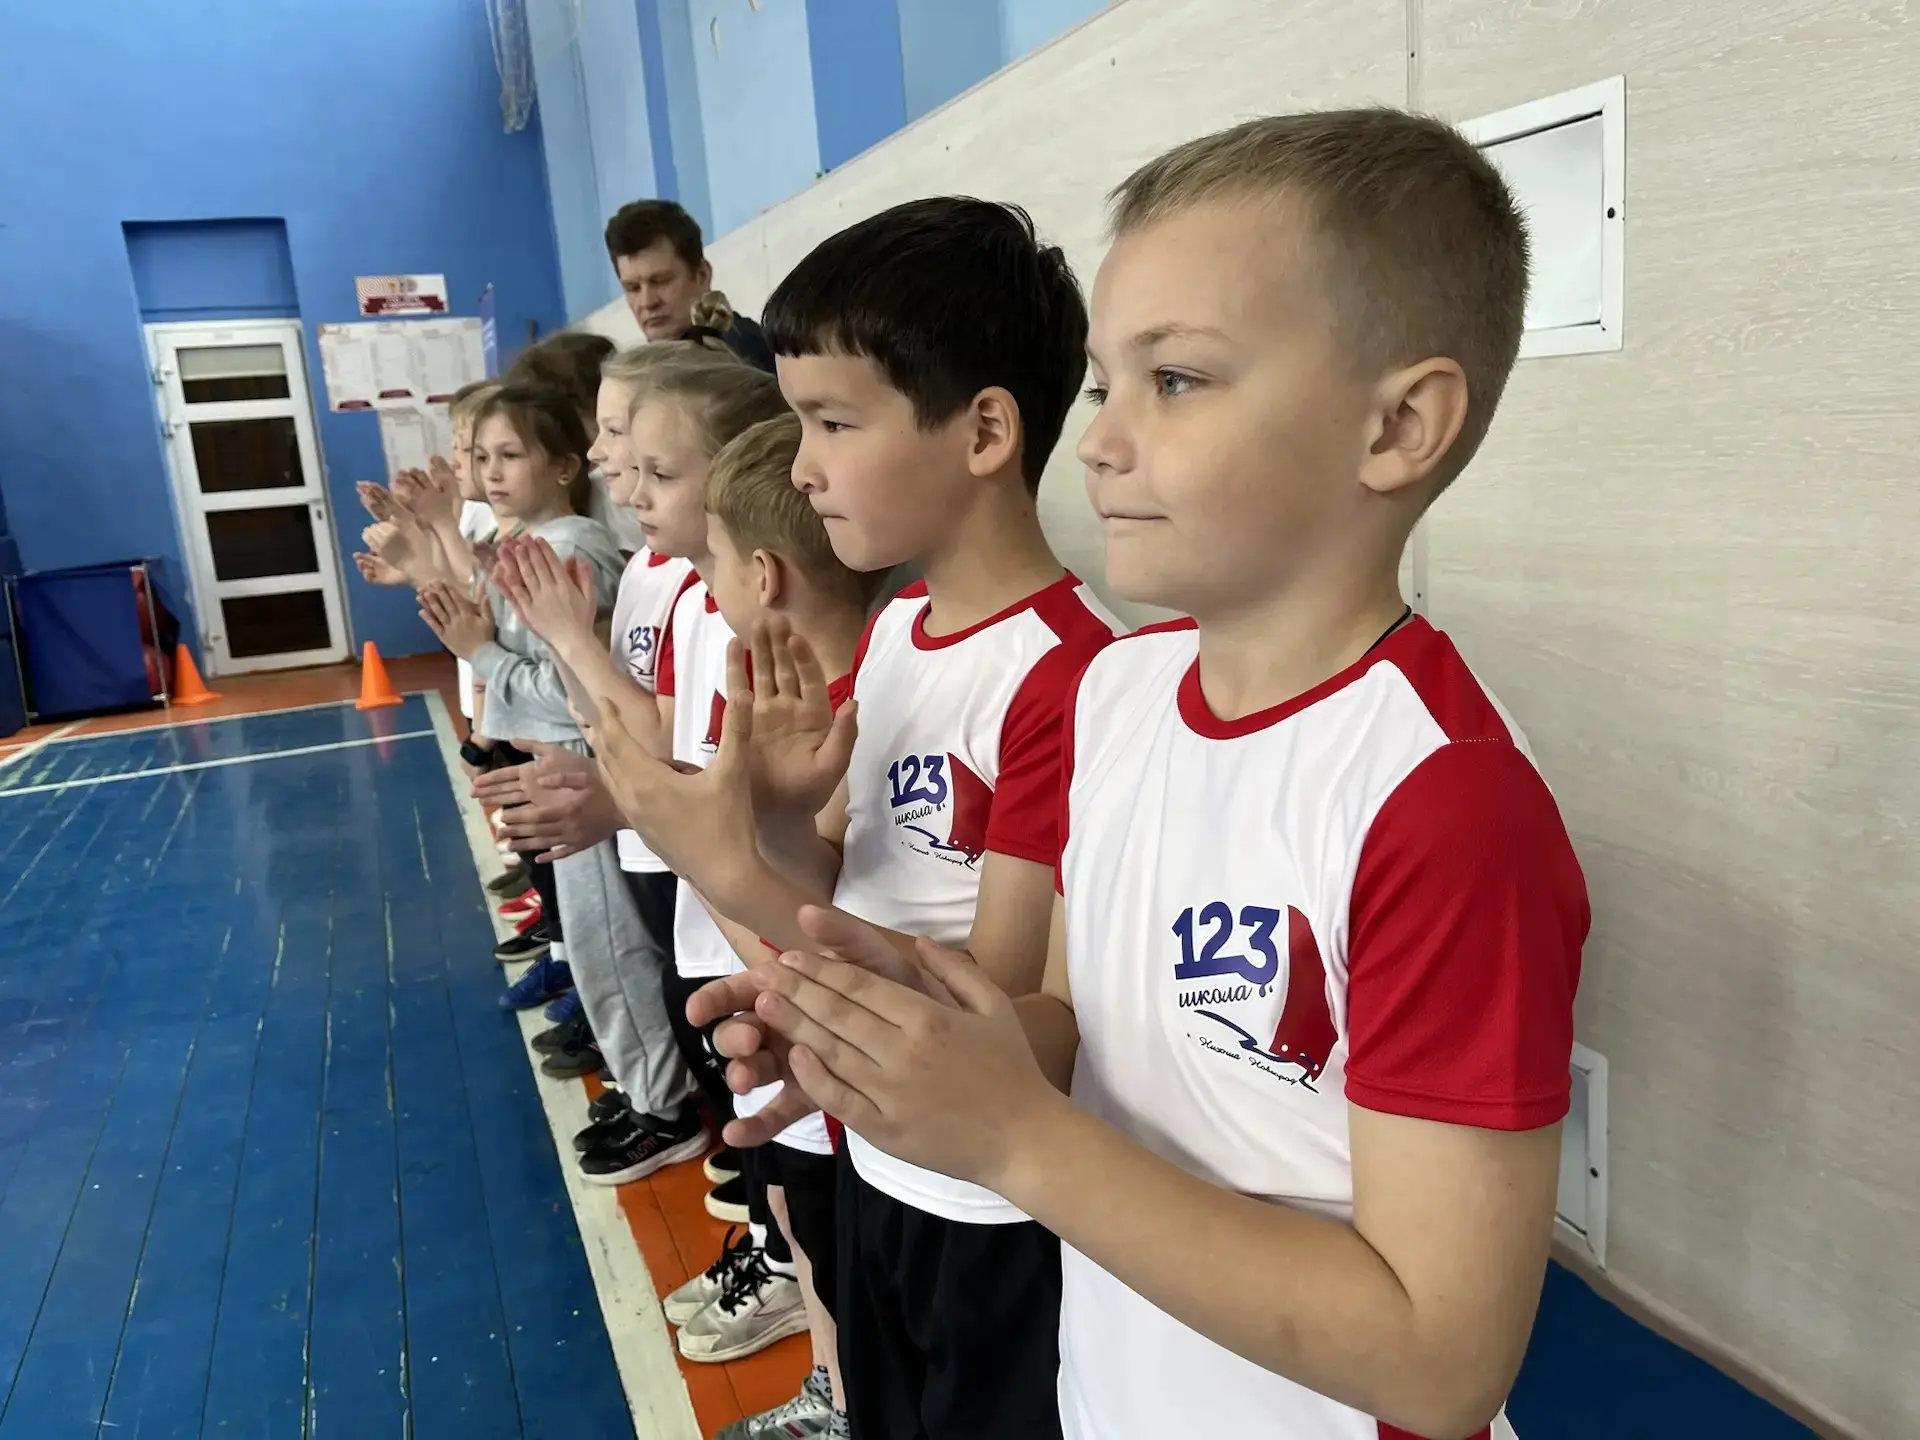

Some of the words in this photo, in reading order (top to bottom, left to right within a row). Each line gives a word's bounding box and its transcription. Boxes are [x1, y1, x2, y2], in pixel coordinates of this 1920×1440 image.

[628, 626, 652, 653] 123
[887, 754, 947, 809] 123
[895, 804, 933, 826] школа
[1171, 901, 1280, 985] 123
[1179, 984, 1252, 1008] школа
